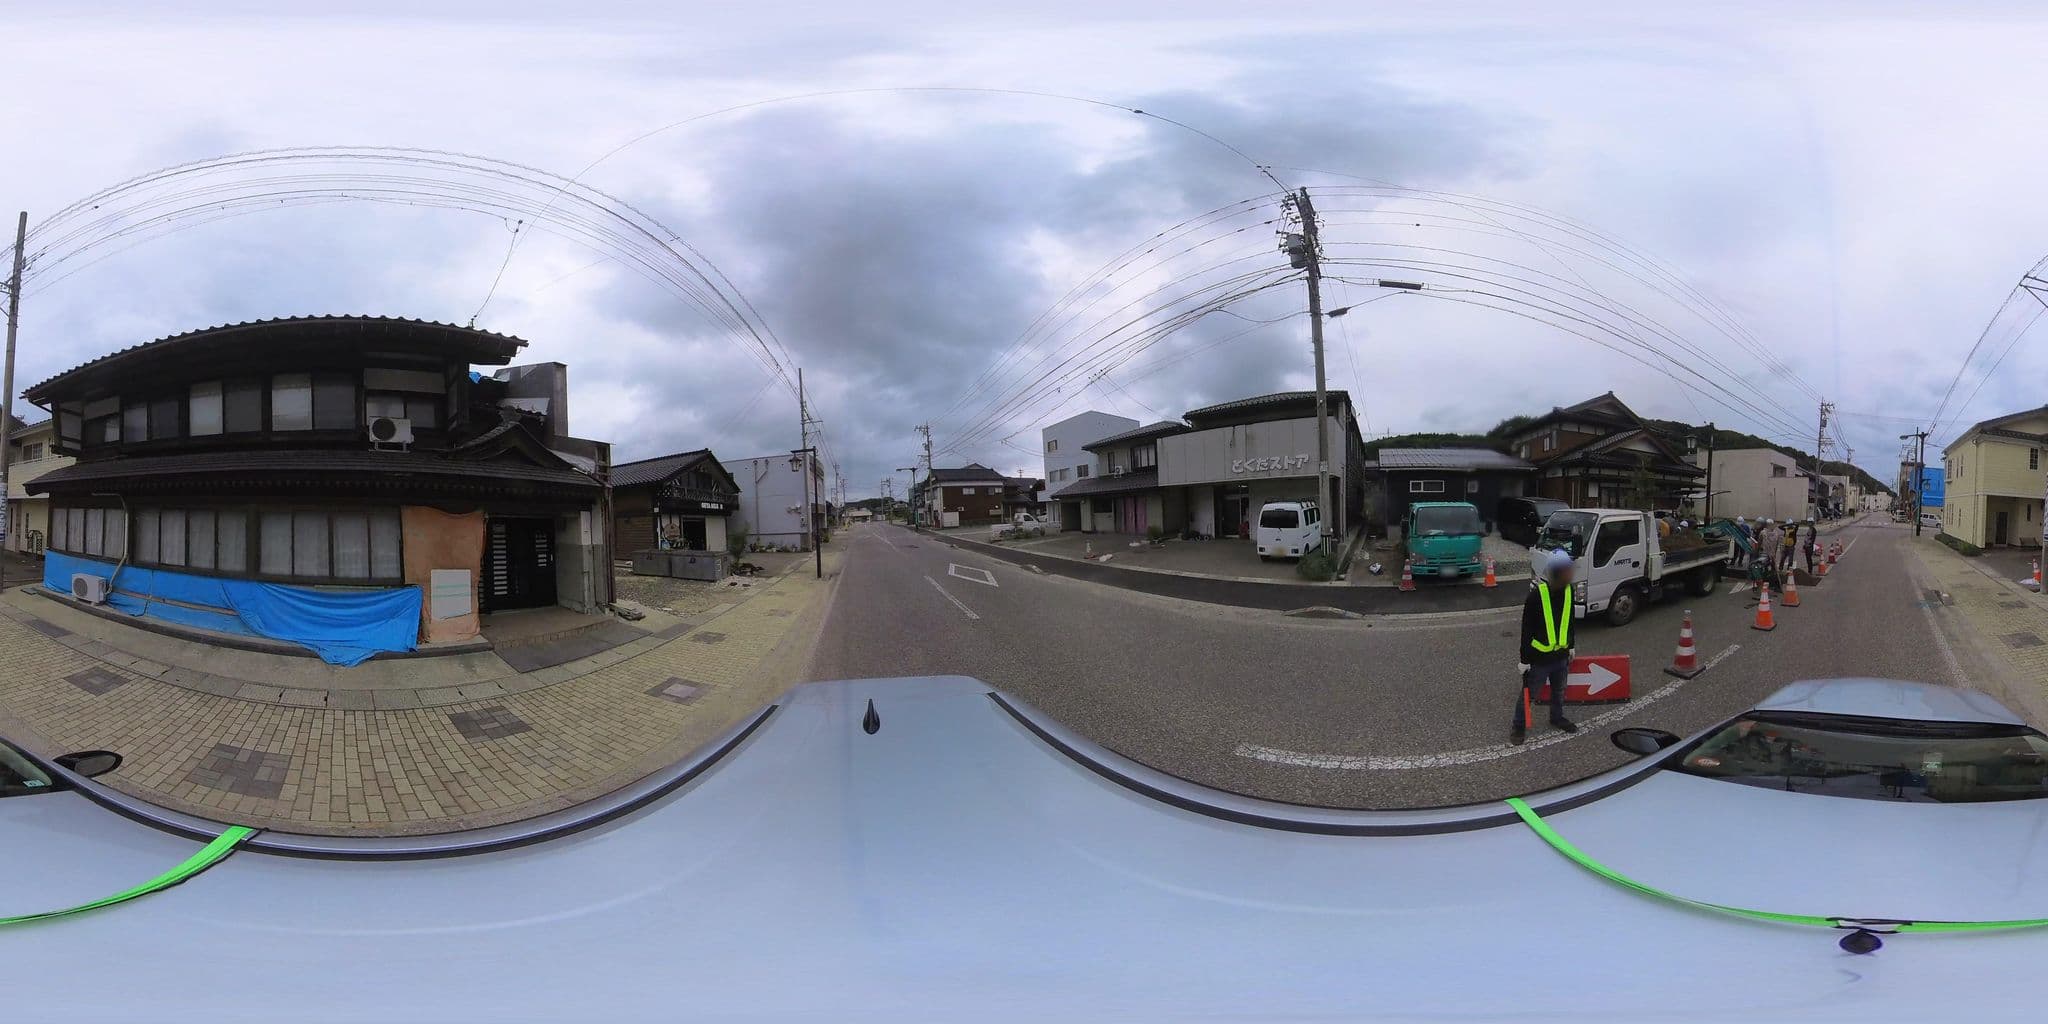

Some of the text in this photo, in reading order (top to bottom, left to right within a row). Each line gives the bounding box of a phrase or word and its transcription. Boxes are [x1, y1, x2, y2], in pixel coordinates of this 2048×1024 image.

[1232, 453, 1309, 474] とくだストア
